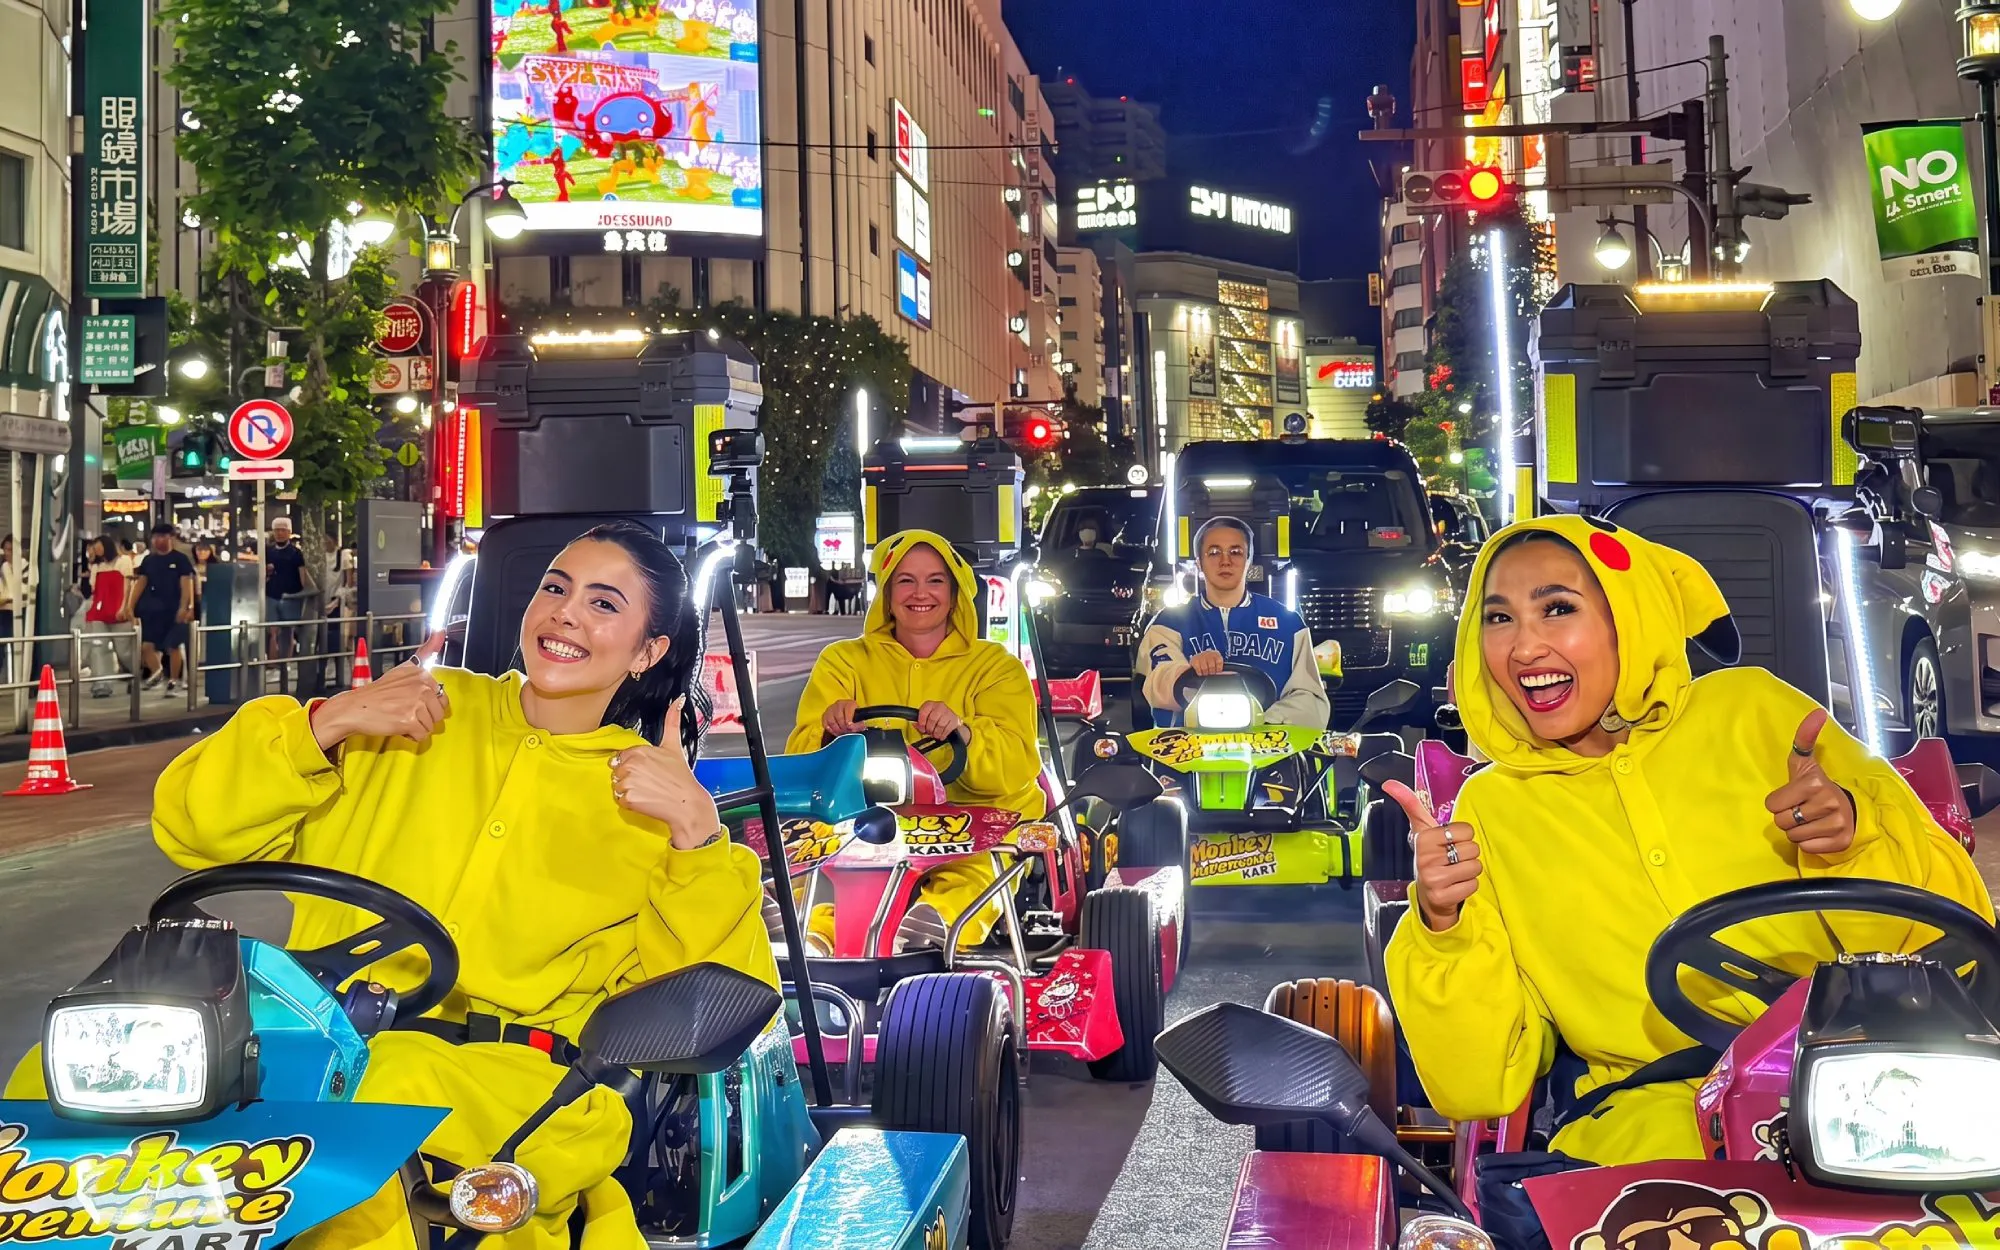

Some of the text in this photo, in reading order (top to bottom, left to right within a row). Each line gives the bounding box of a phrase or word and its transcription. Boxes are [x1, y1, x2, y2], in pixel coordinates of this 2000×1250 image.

[101, 96, 137, 235] 眼鏡市場
[1880, 150, 1957, 199] NO
[1077, 184, 1136, 212] ニトリ
[1190, 631, 1284, 664] JAPAN
[909, 843, 972, 855] KART
[1190, 833, 1272, 863] Monkey
[1242, 863, 1277, 879] KART
[110, 1228, 275, 1250] KART
